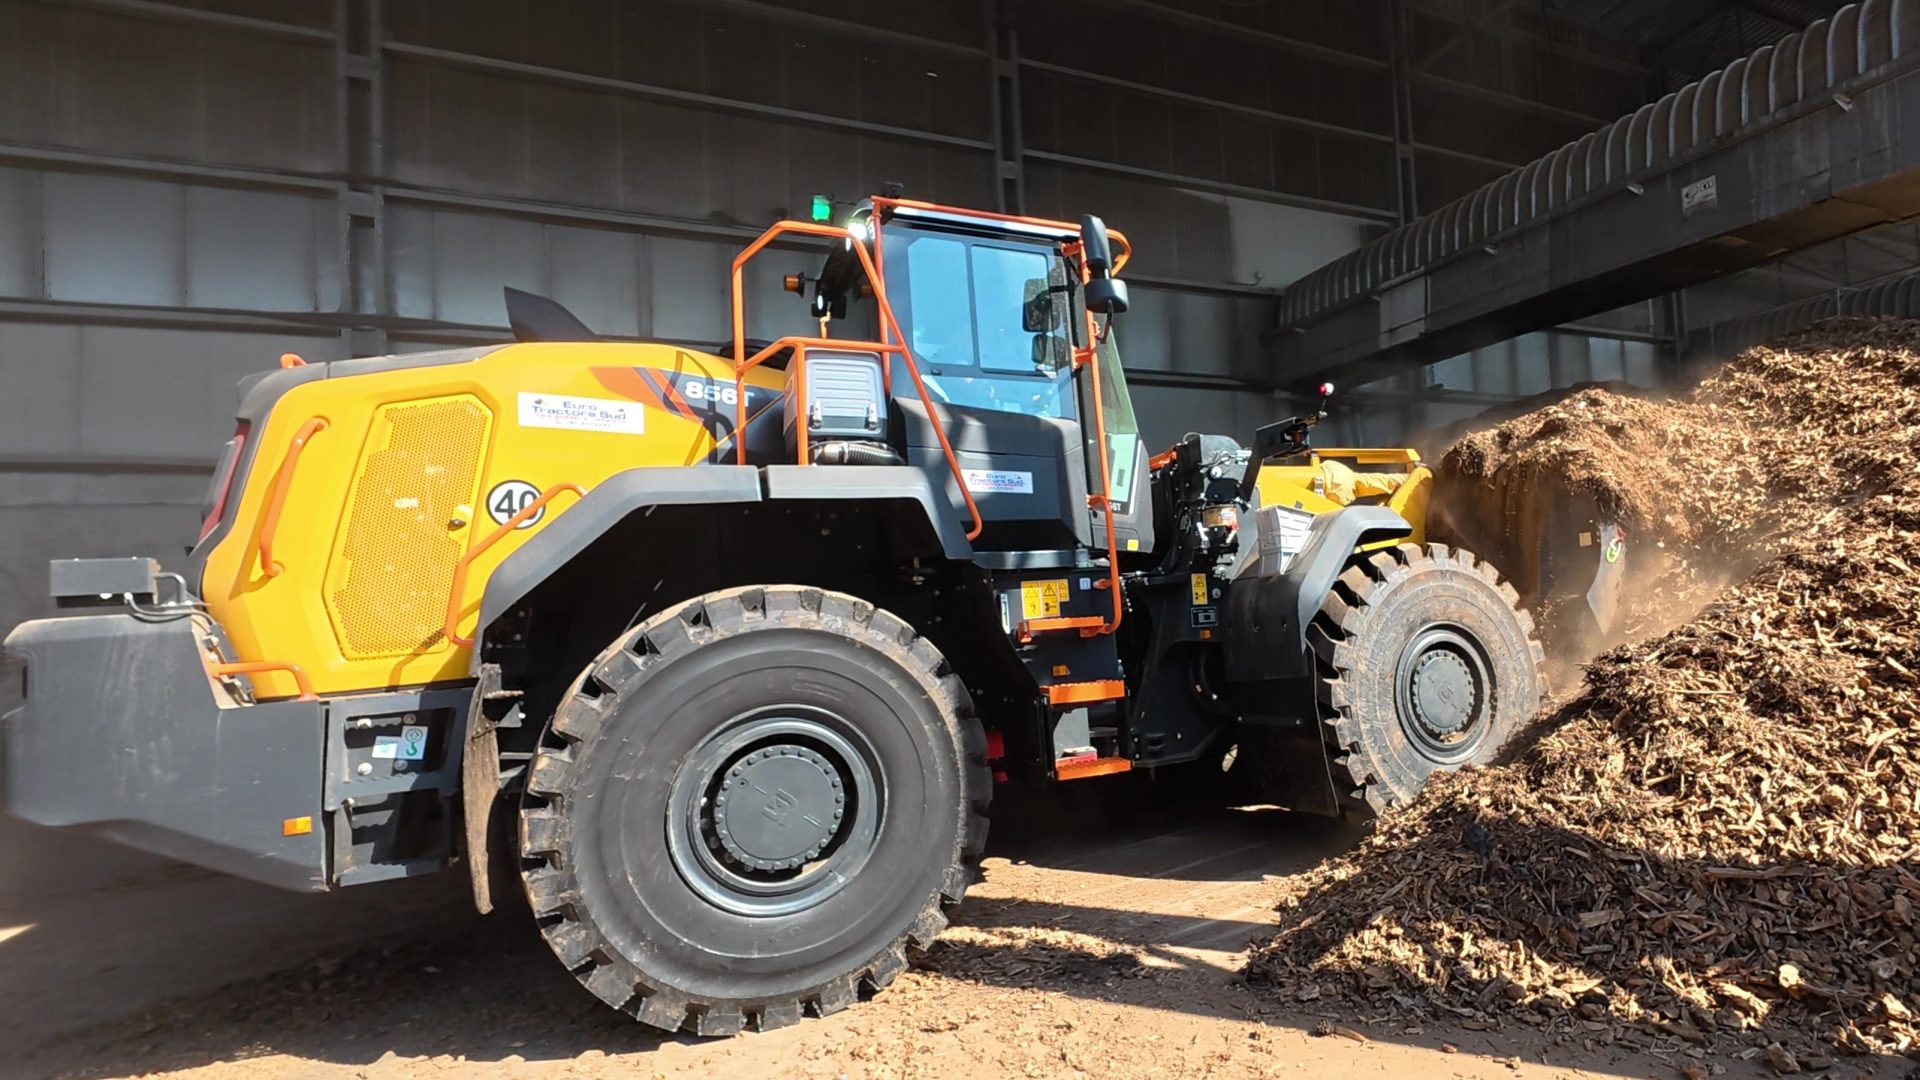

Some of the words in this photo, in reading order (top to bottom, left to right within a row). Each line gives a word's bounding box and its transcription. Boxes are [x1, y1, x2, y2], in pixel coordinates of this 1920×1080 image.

[685, 381, 755, 407] 856T
[531, 405, 596, 418] Tractors
[600, 411, 626, 420] Sud
[563, 401, 597, 411] Euro
[494, 489, 538, 520] 40
